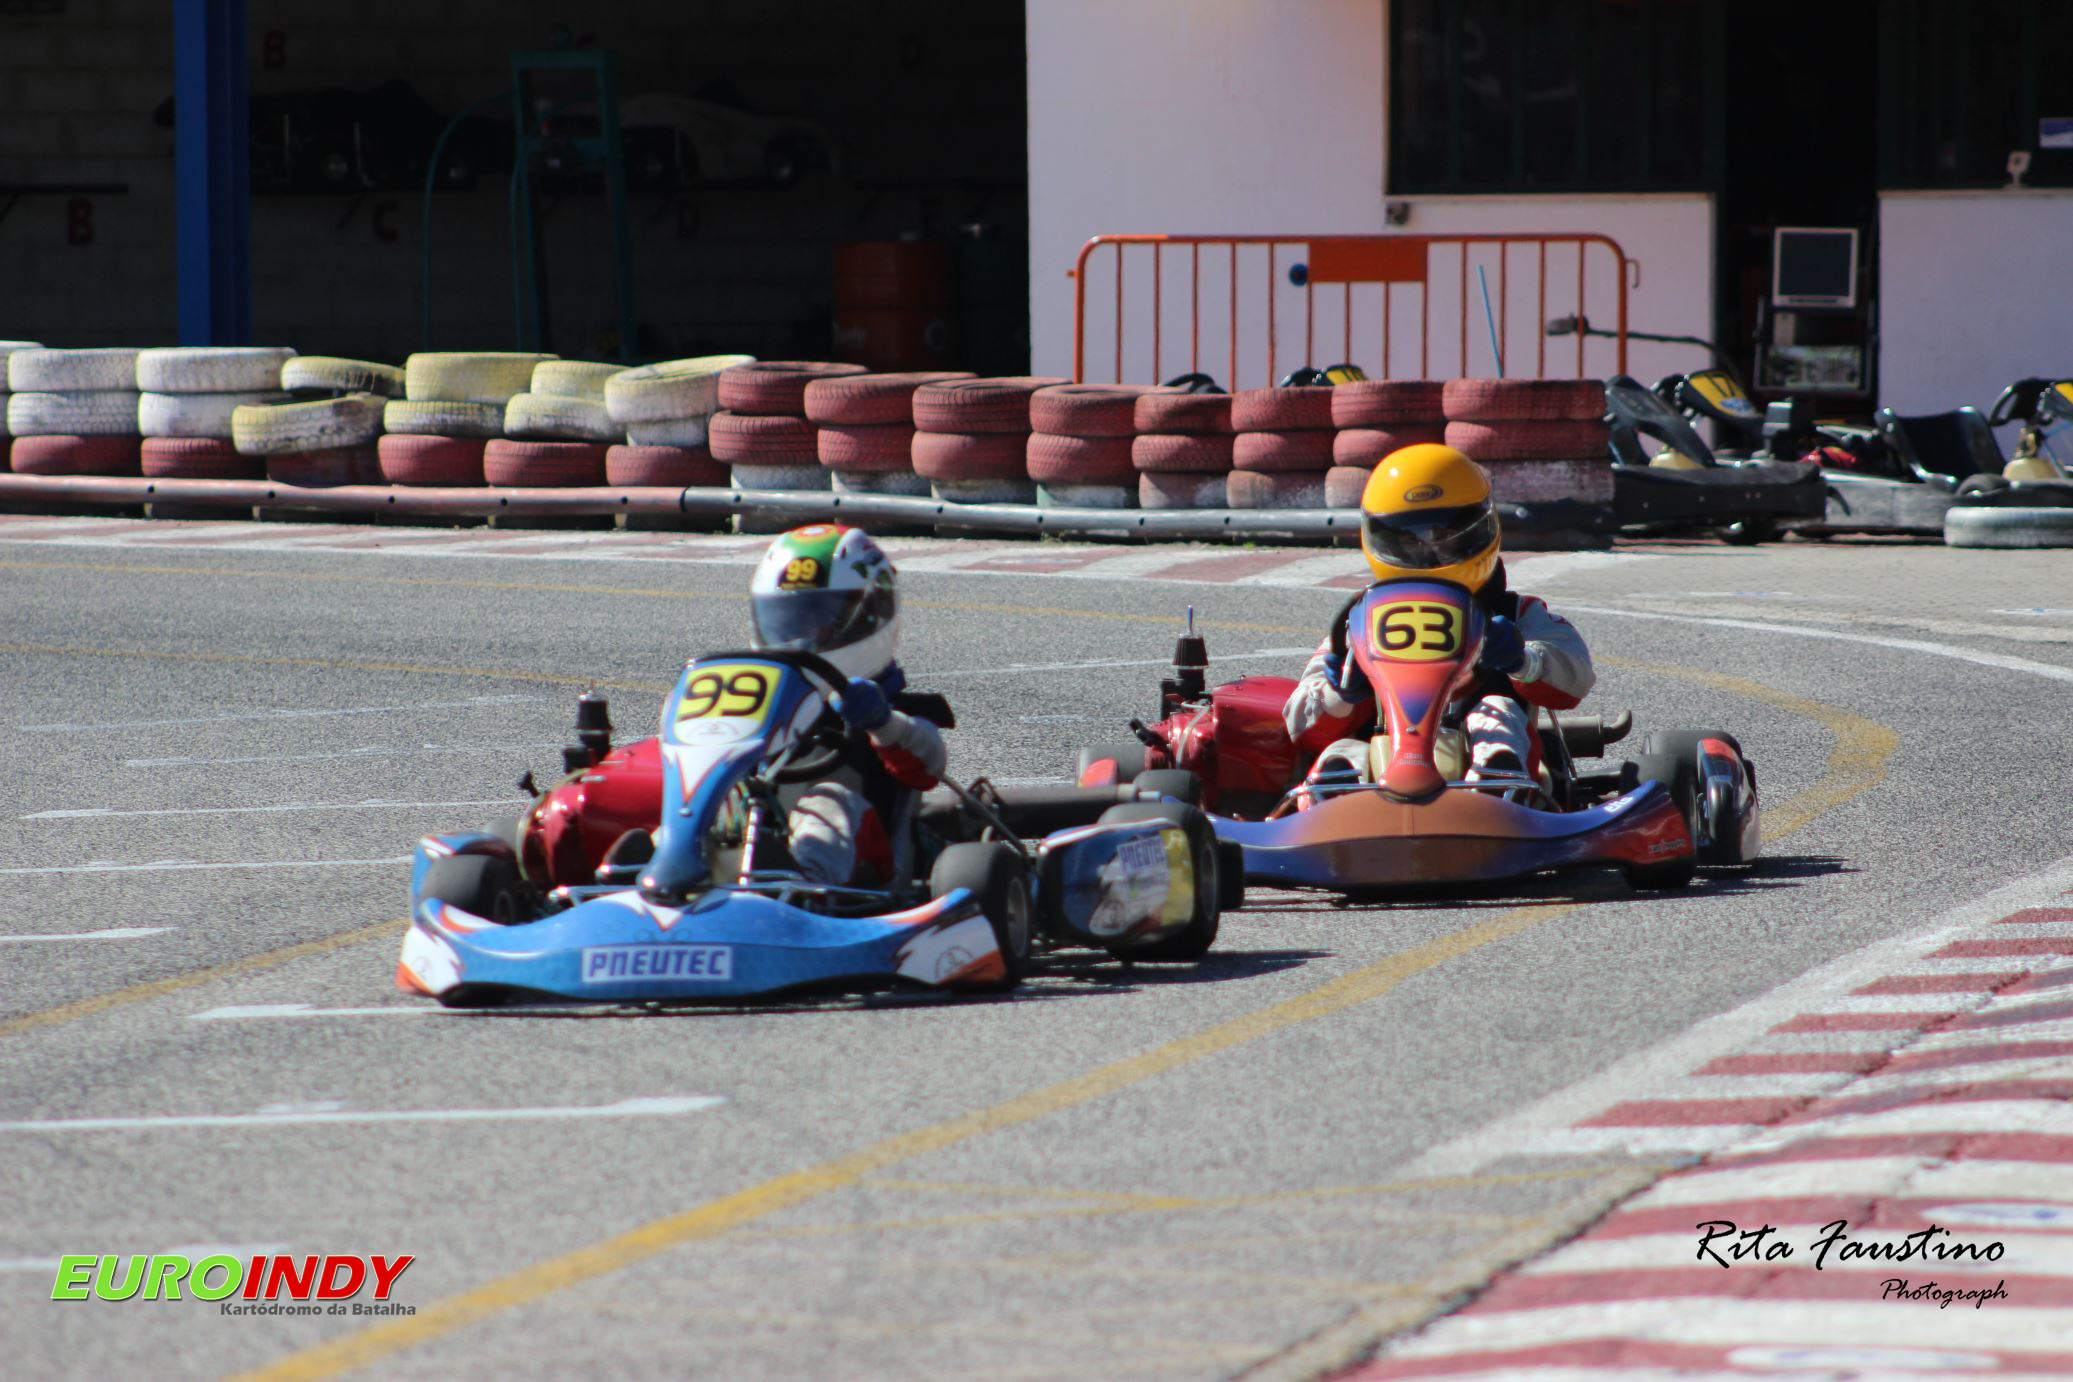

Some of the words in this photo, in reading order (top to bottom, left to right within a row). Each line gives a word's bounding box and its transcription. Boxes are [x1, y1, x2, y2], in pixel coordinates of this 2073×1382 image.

[263, 31, 288, 69] B
[67, 199, 94, 245] B
[373, 199, 399, 242] C
[786, 559, 817, 581] 99
[1377, 604, 1456, 652] 63
[677, 669, 768, 722] 99
[588, 949, 728, 978] PNEUTEC
